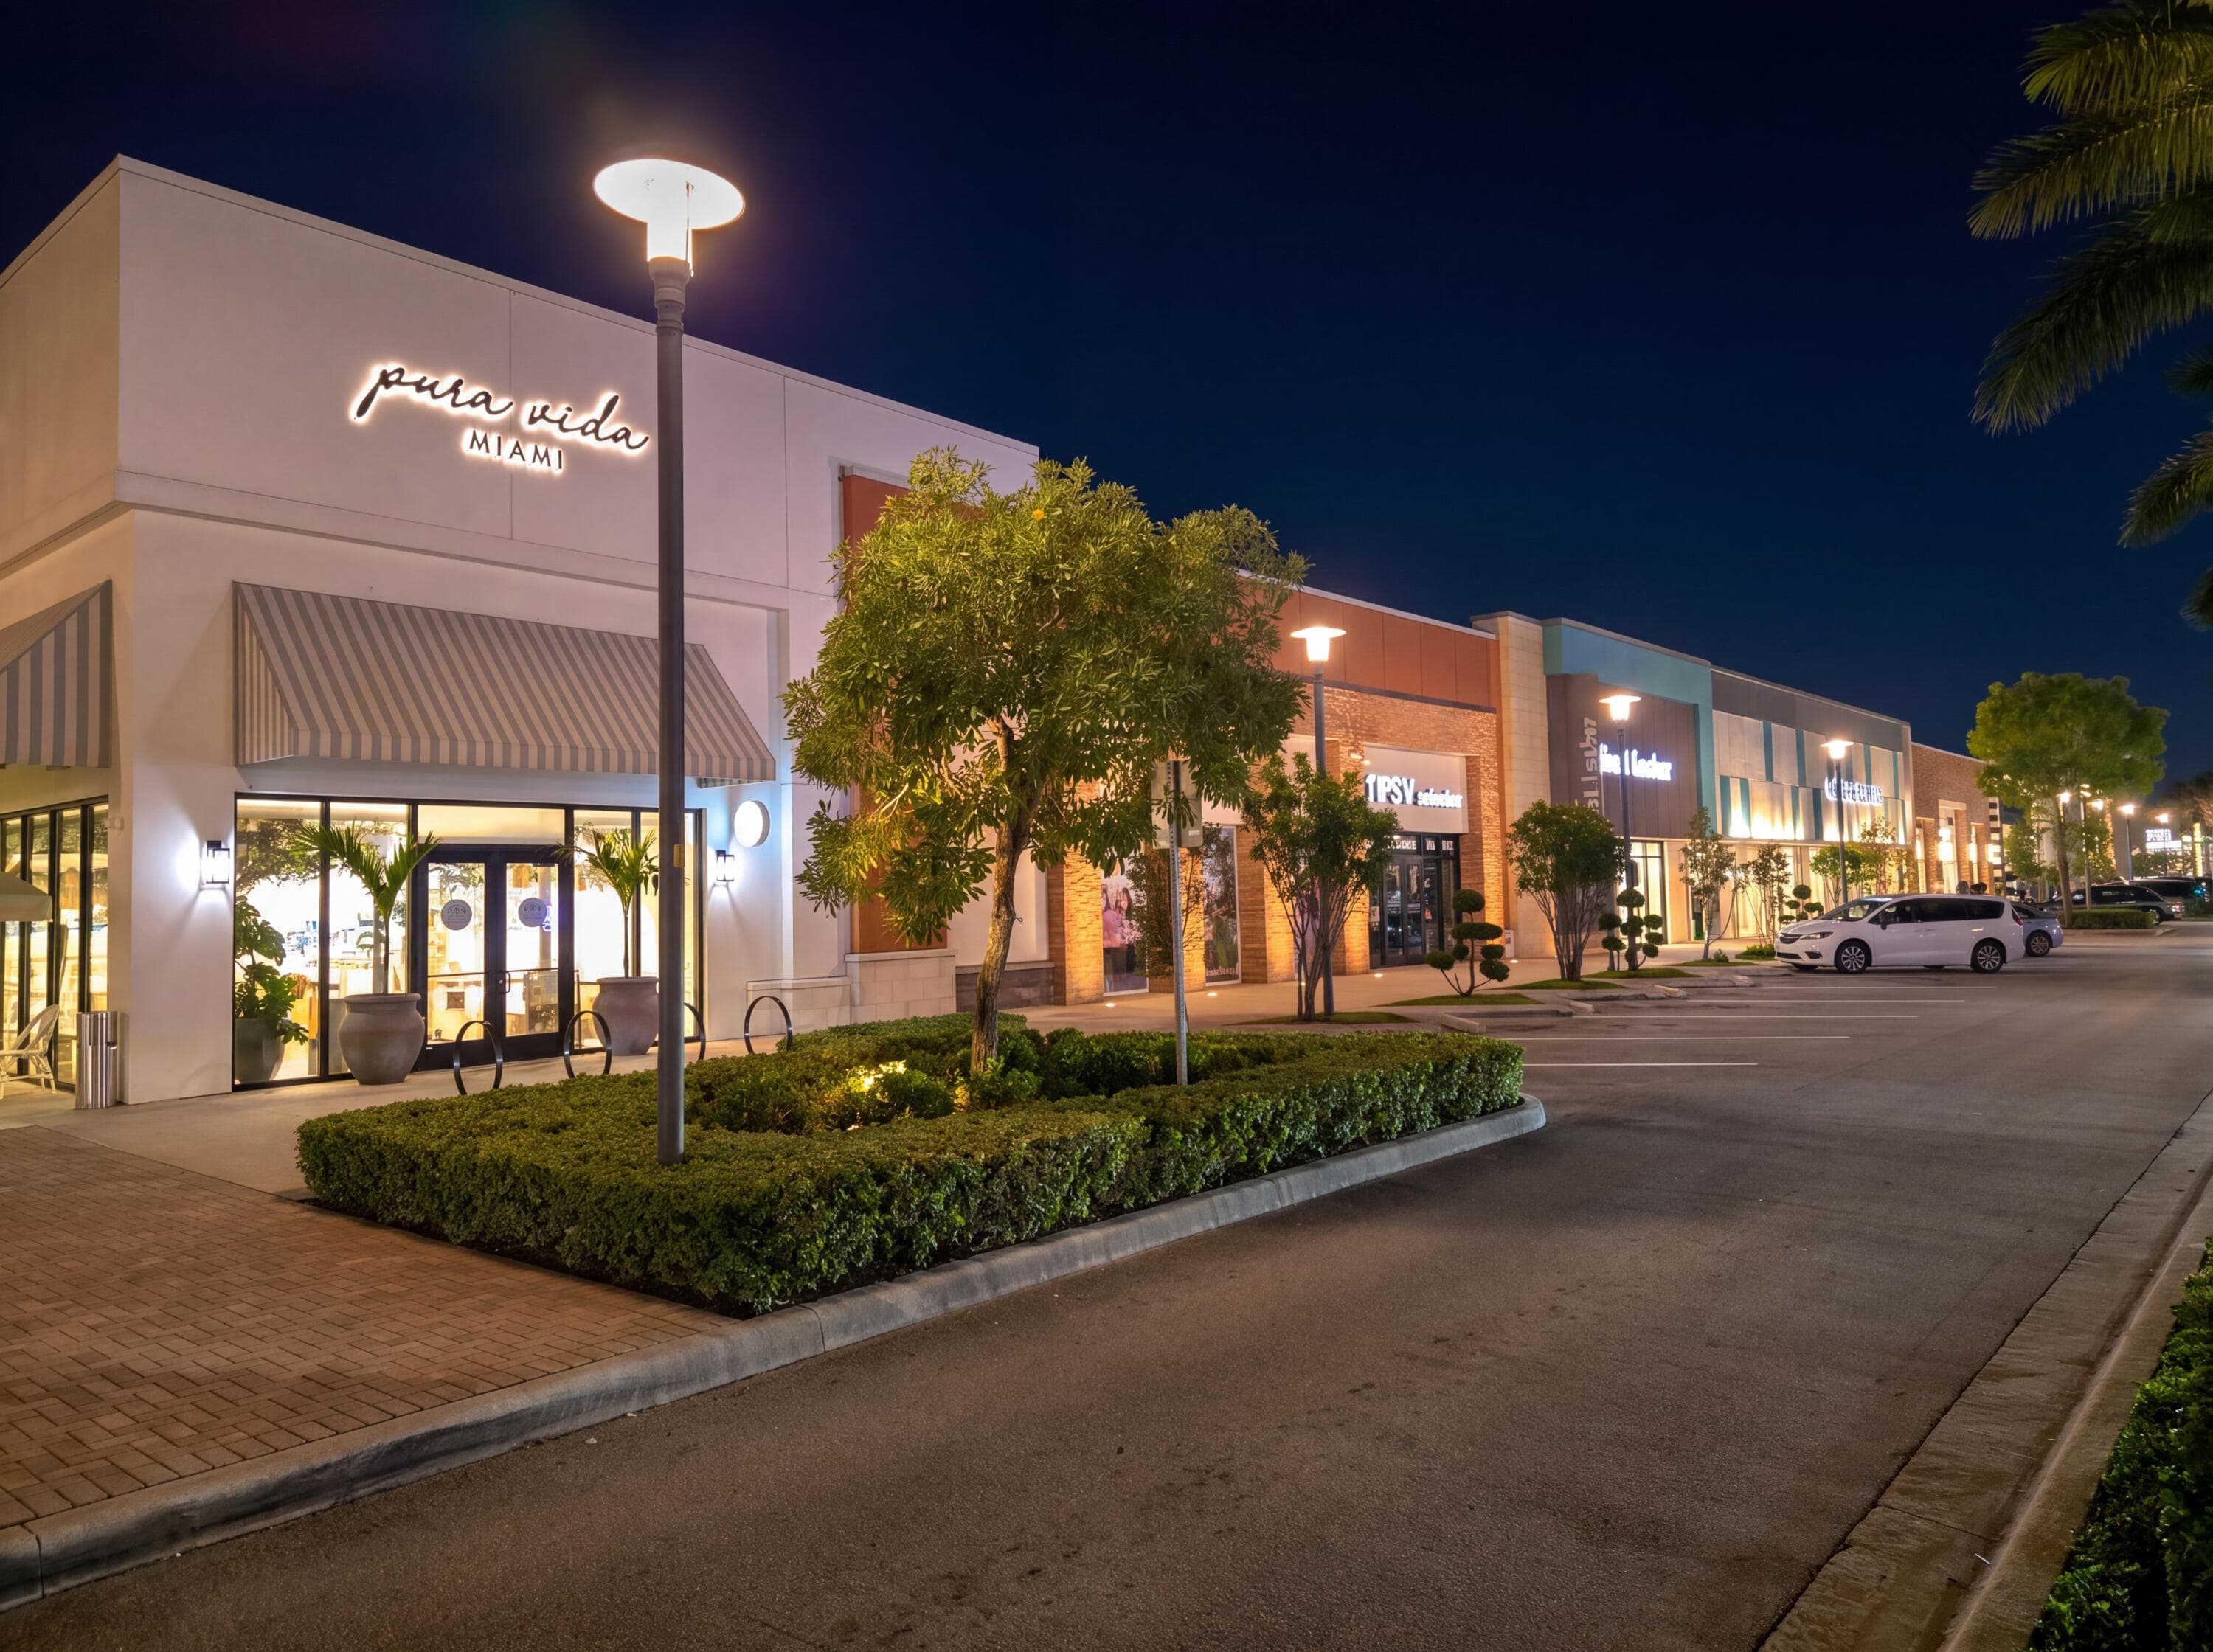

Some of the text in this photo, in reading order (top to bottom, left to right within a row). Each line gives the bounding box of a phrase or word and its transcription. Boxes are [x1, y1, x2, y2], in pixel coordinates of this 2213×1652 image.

[354, 367, 650, 450] pura vida
[468, 429, 564, 470] MIAMI
